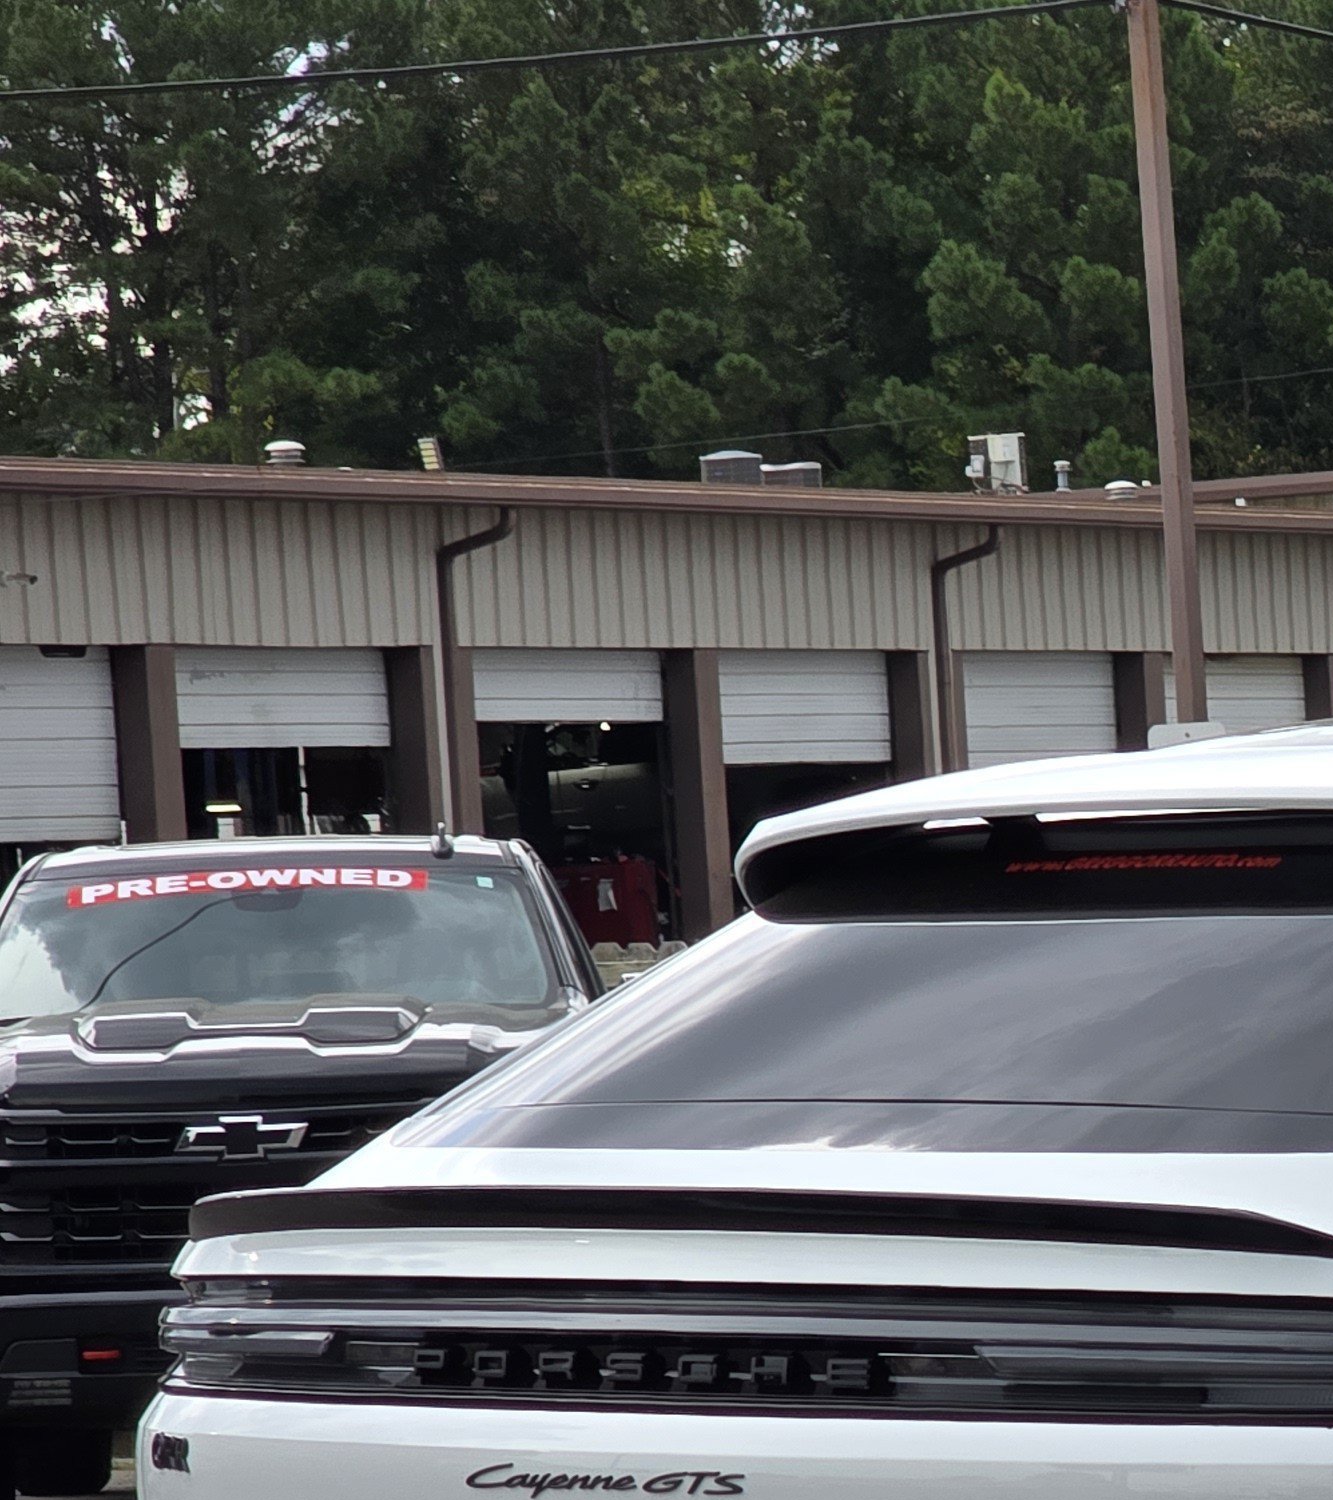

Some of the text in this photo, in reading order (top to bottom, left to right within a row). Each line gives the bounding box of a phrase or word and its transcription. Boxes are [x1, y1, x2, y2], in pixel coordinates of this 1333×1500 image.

[81, 868, 413, 905] PRE-OWNED
[413, 1348, 870, 1390] PORSCHE
[465, 1461, 745, 1499] Cayenne GTS
